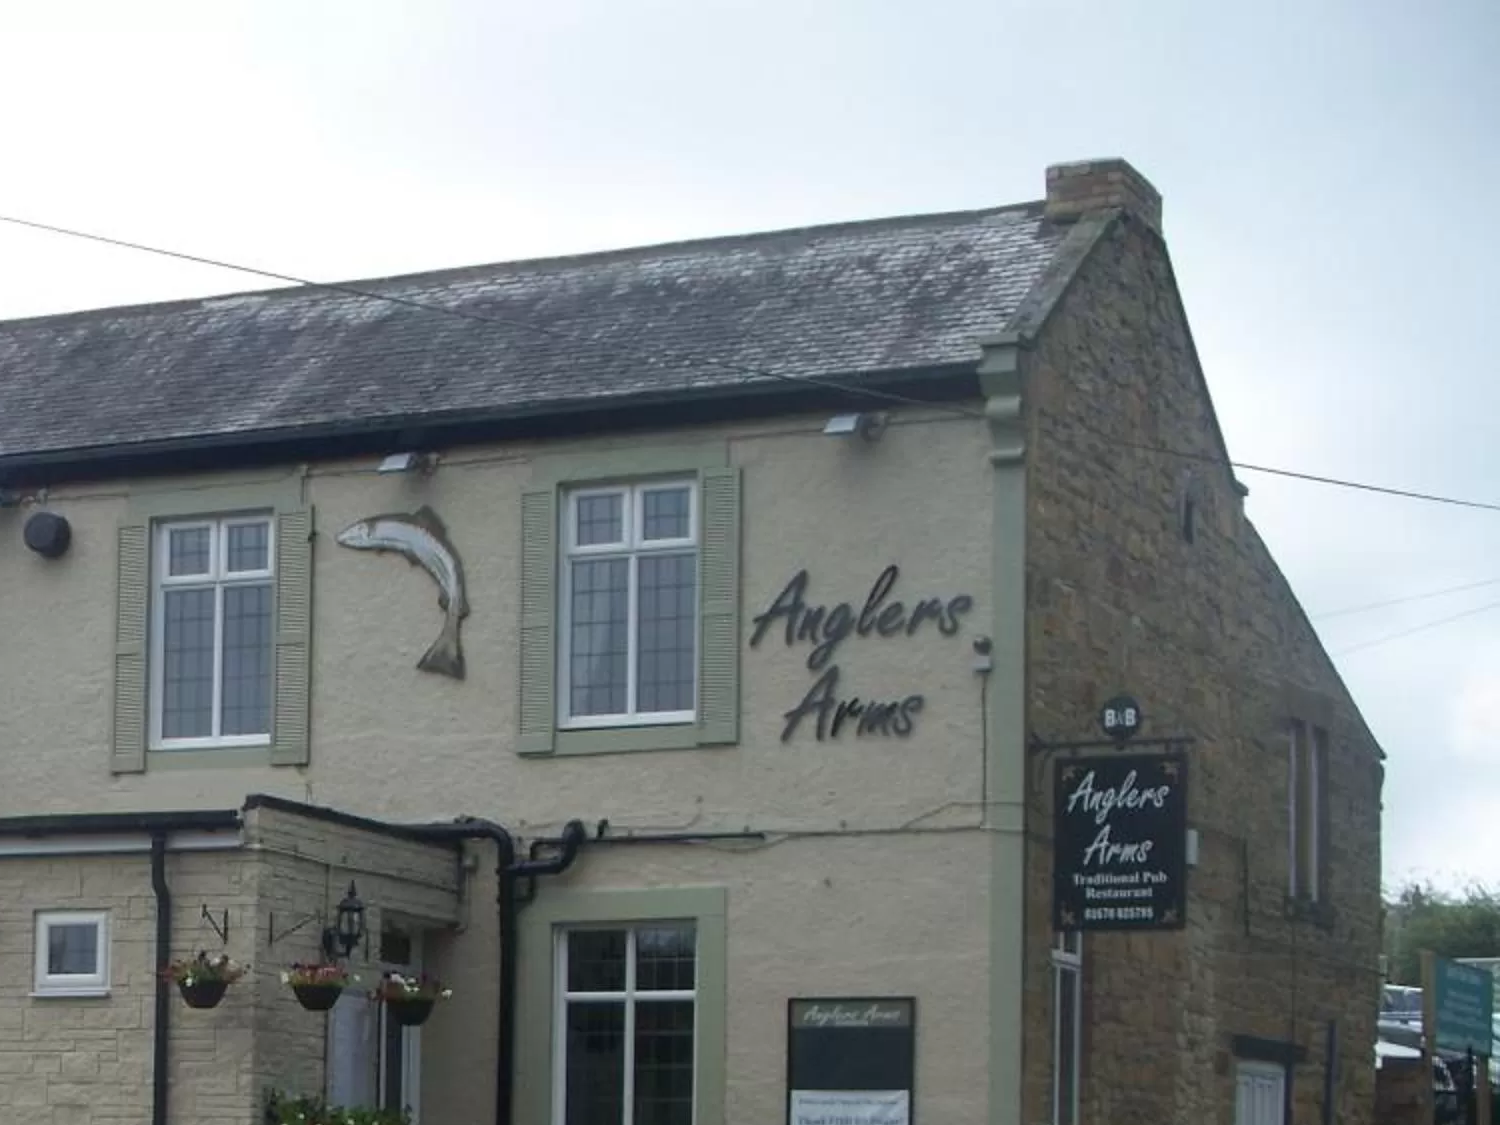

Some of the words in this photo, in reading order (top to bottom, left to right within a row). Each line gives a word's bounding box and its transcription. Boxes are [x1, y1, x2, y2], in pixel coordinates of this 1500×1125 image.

[749, 565, 973, 670] Anglers
[781, 664, 924, 743] Arms
[1067, 769, 1171, 824] Anglers
[1083, 823, 1153, 866] Arms
[1073, 872, 1140, 885] Traditional
[1143, 871, 1168, 883] Pub
[1085, 887, 1154, 899] Restaurant
